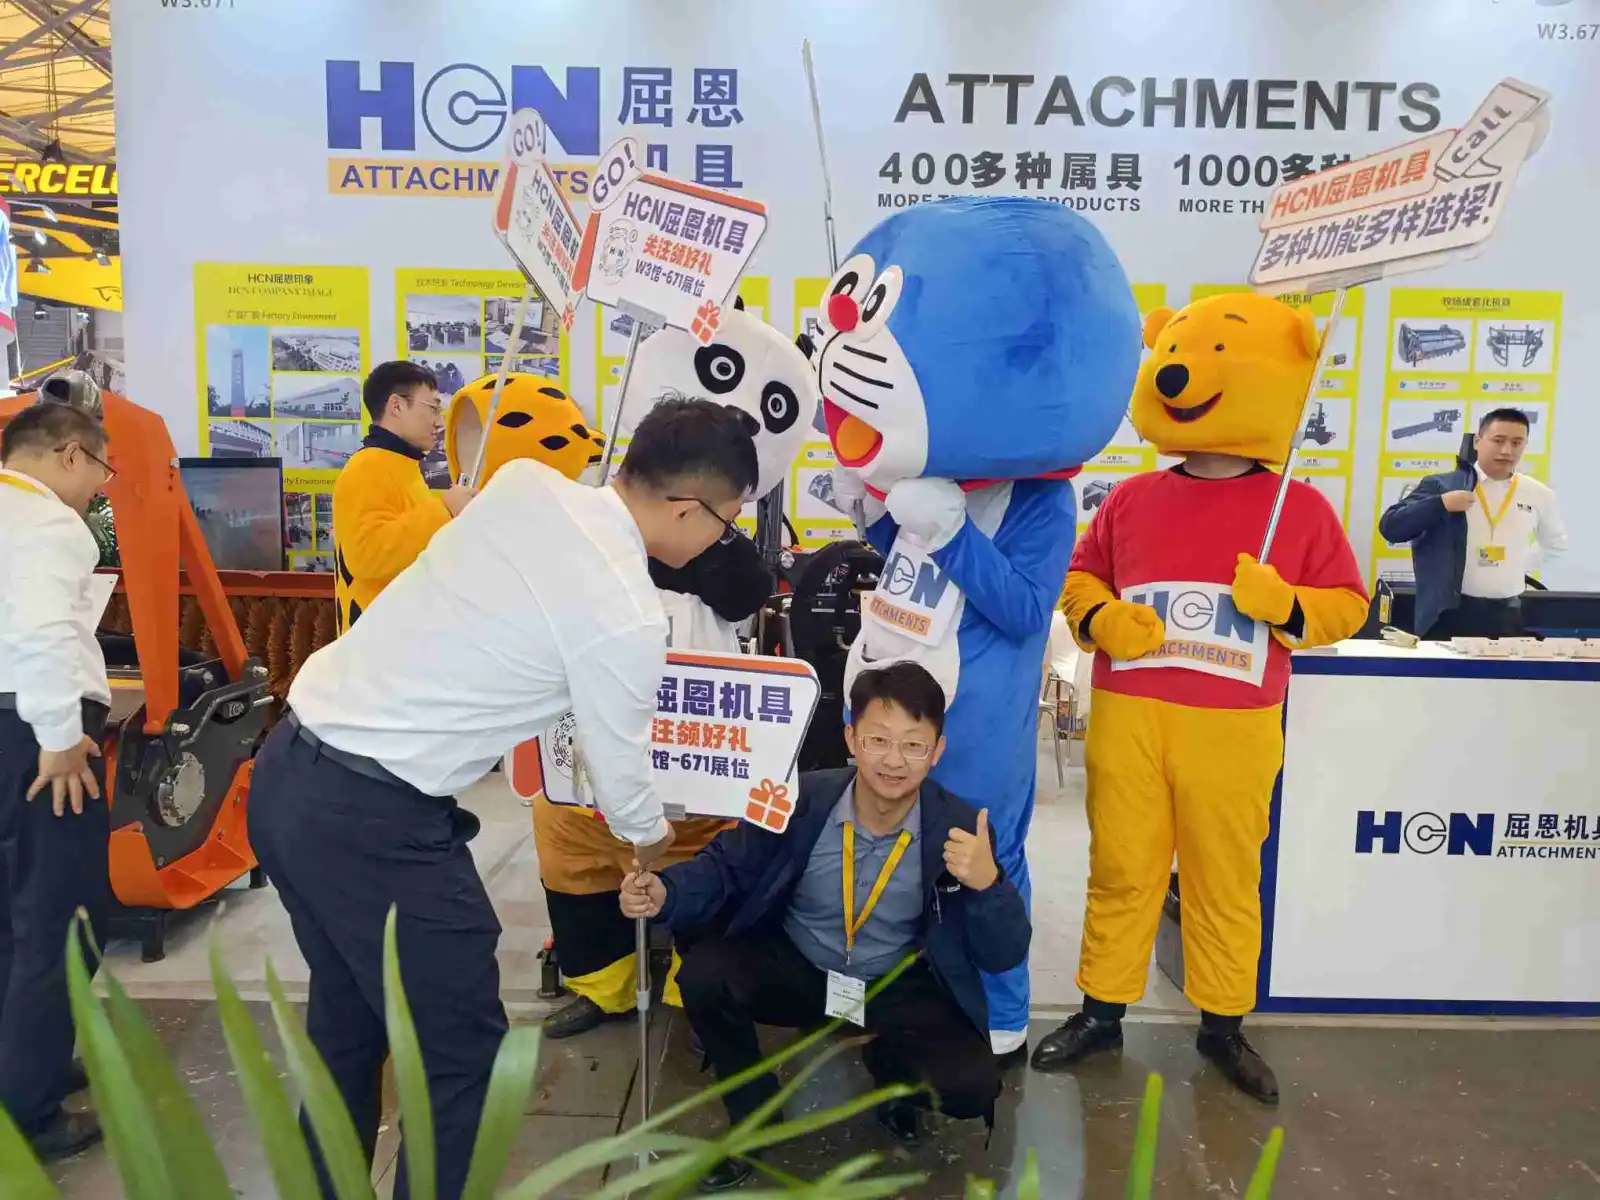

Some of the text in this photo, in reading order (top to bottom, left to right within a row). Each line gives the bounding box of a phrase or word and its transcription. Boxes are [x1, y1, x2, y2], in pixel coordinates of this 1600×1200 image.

[1537, 23, 1600, 40] W3.67
[326, 60, 600, 156] HCN
[618, 66, 745, 128] 屈恩
[894, 73, 1442, 133] ATTACHMENTS
[513, 119, 542, 157] GO!
[340, 163, 590, 195] ATTACHMTS
[592, 142, 635, 203] GO!
[878, 150, 1143, 190] 400多种属具
[1271, 149, 1431, 220] HCN屈恩机具
[532, 169, 580, 261] HCN屈恩机
[622, 191, 749, 254] HCN屈恩机具
[1179, 198, 1265, 213] MORE TH
[1259, 181, 1502, 271] 多种功能多样选择!
[643, 234, 713, 276] 关注领好礼
[635, 258, 705, 297] W3馆-671展位
[1151, 641, 1249, 668] ACHMENTS
[656, 676, 793, 724] 屈恩机具
[651, 717, 753, 753] 注领好礼
[650, 749, 750, 779] 馆-671展位
[1355, 810, 1495, 856] HCN
[1496, 845, 1600, 860] ATTACHMEN
